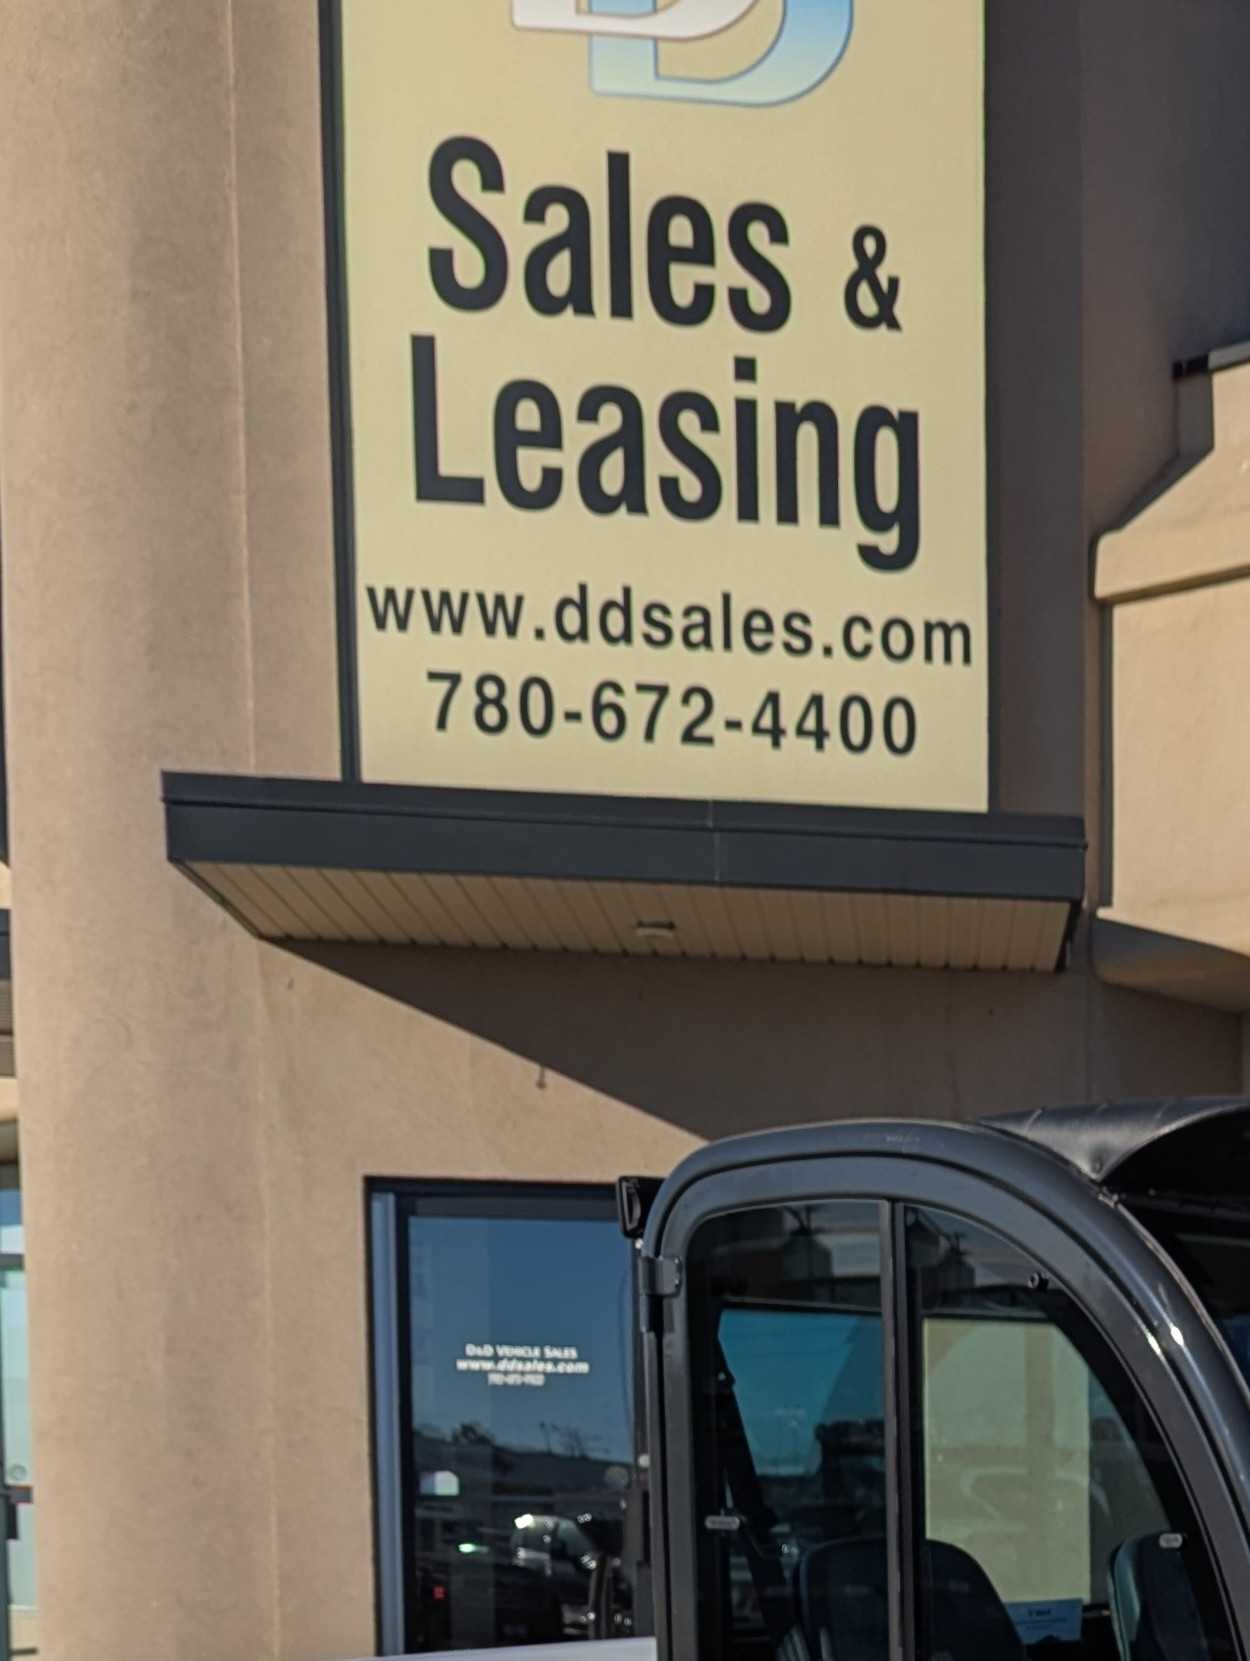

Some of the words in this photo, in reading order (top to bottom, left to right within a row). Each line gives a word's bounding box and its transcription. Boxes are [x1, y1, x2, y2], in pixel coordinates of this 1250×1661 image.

[428, 135, 793, 333] Sales
[843, 224, 903, 332] &
[410, 333, 921, 572] Leasing
[366, 582, 973, 665] www.ddsales.com
[426, 670, 918, 756] 780-672-4400
